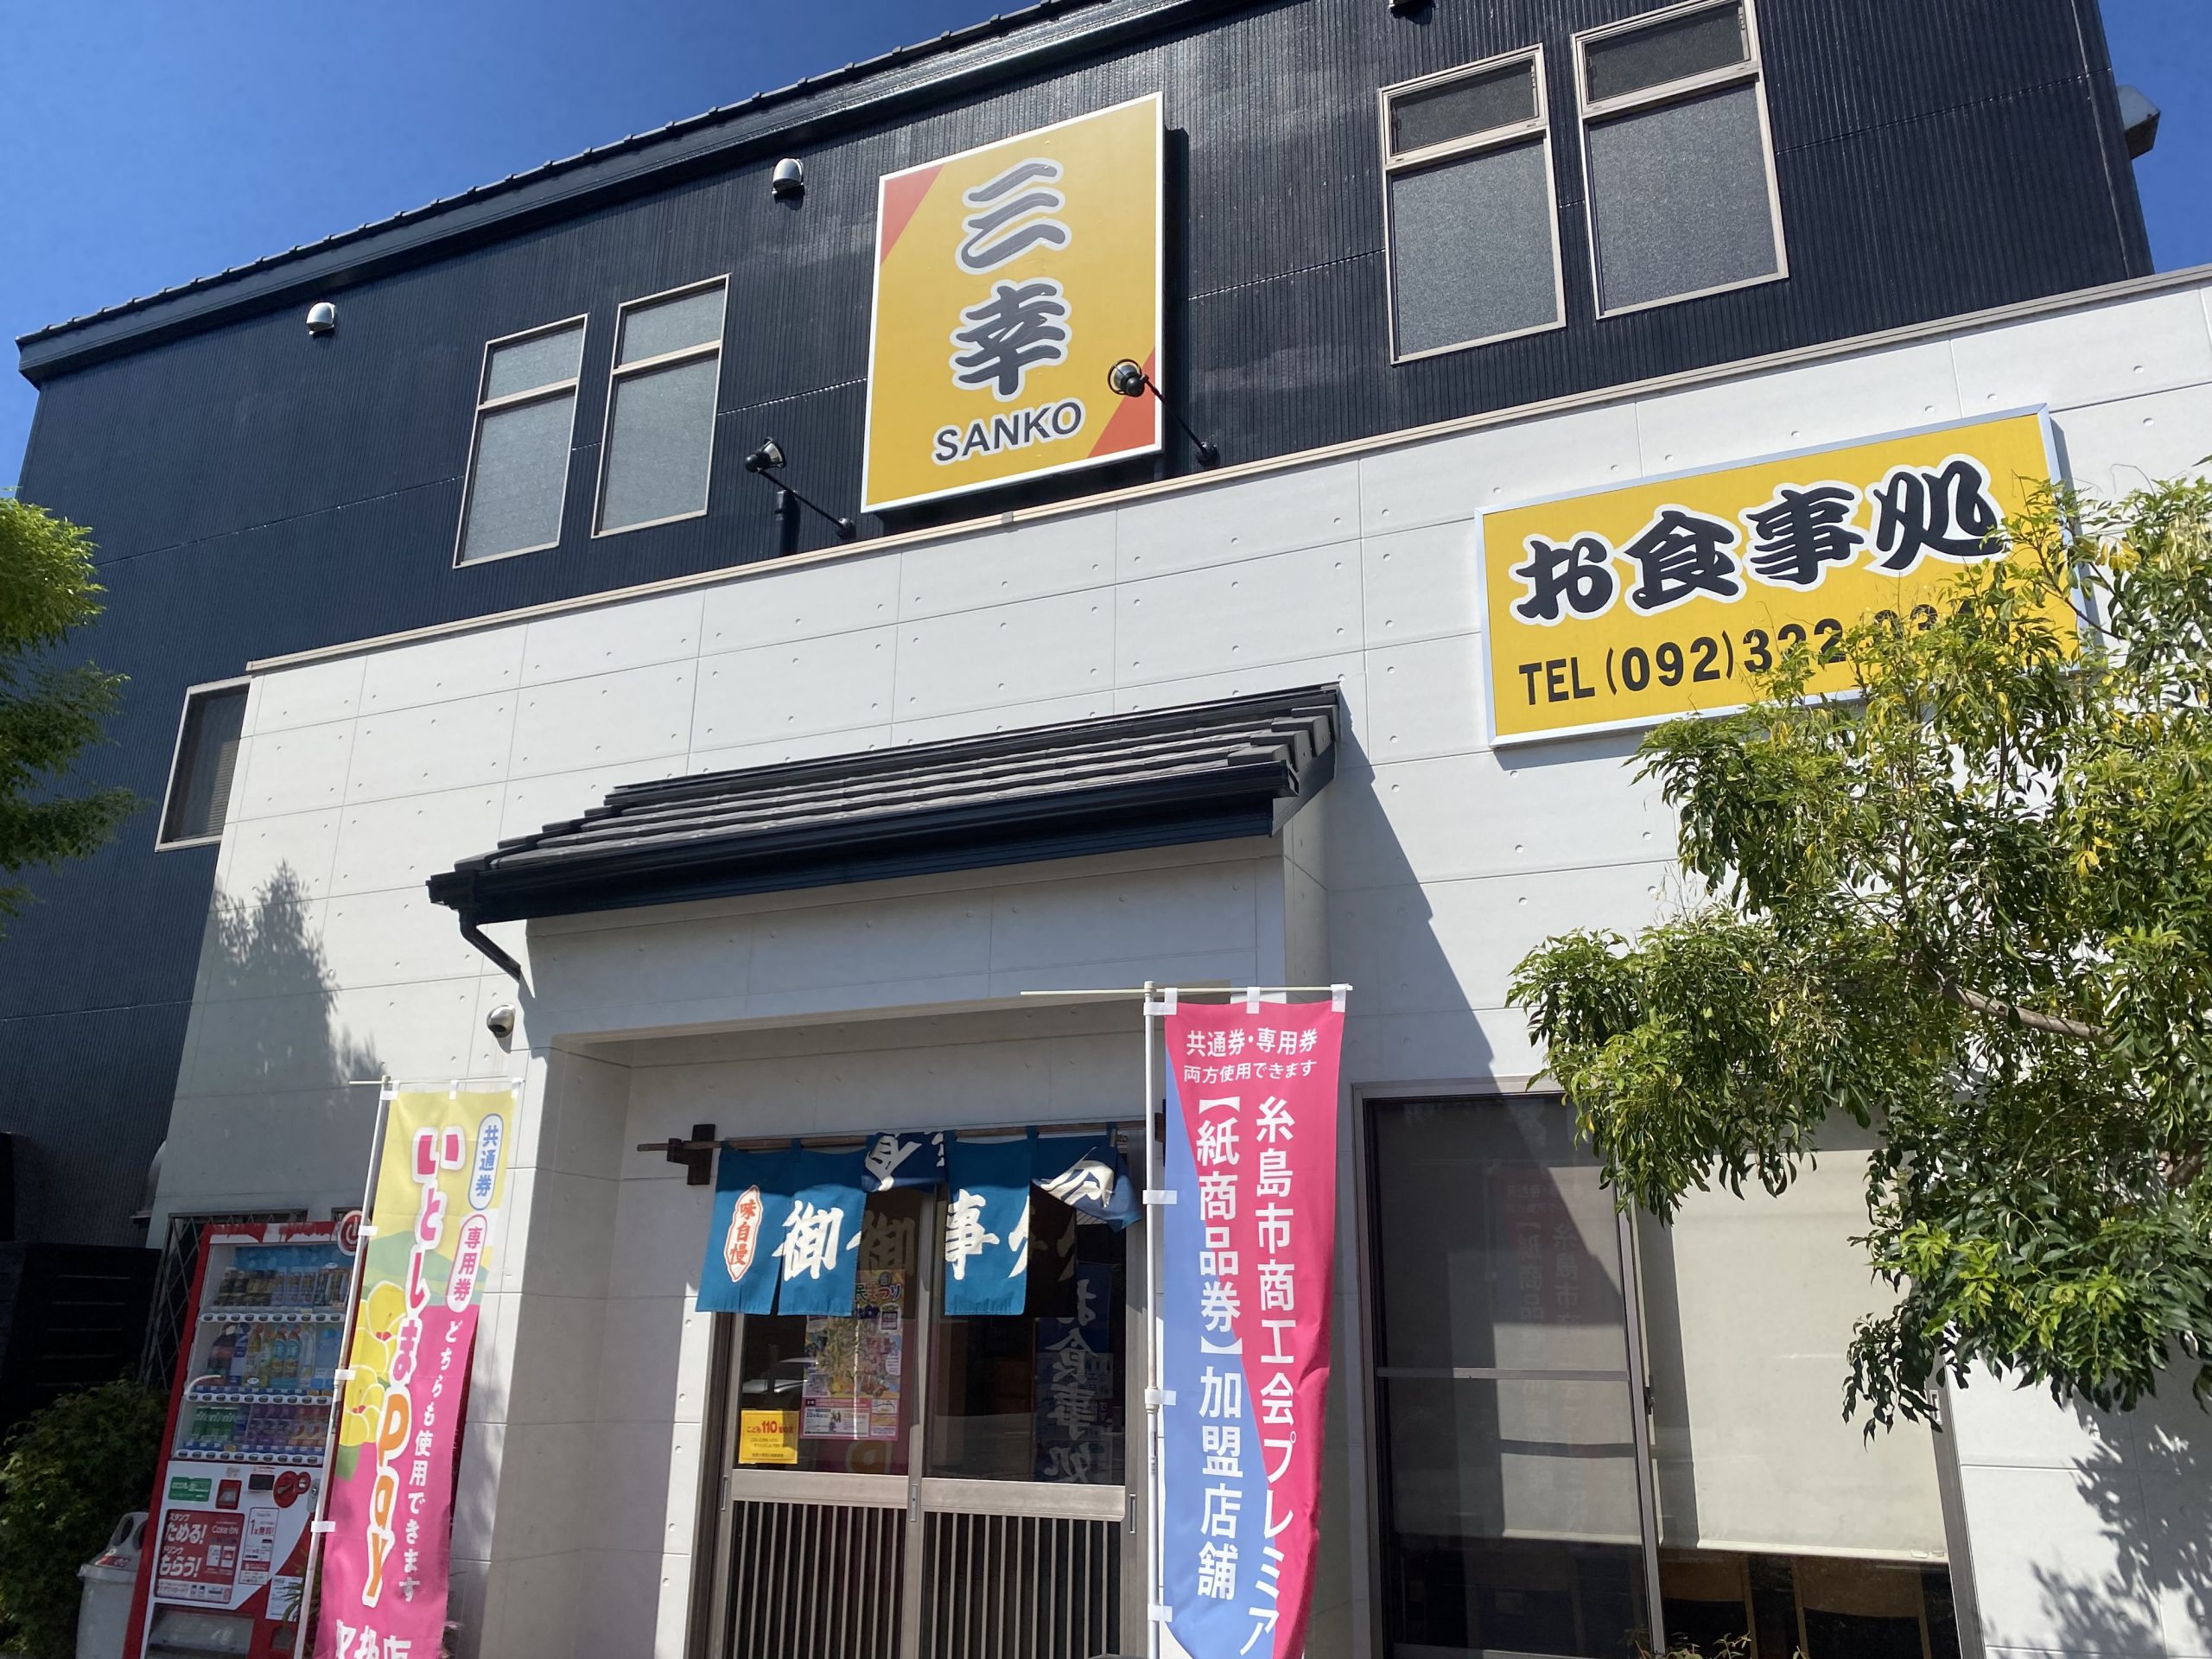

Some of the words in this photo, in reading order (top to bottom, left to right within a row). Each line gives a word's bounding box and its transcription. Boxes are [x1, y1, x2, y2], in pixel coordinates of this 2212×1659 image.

[954, 162, 1067, 397] 三幸
[935, 403, 1083, 462] SANKO
[1516, 459, 2006, 620] お食事処
[1518, 658, 1595, 706] TEL
[1183, 1058, 1317, 1084] 両方使用できます
[475, 1124, 499, 1198] 共通券
[454, 1225, 484, 1302] 専用券
[728, 1198, 757, 1267] 味自慢
[1240, 1096, 1296, 1656] 糸島市商工会プレミア
[398, 1319, 463, 1603] どちらも使用できます
